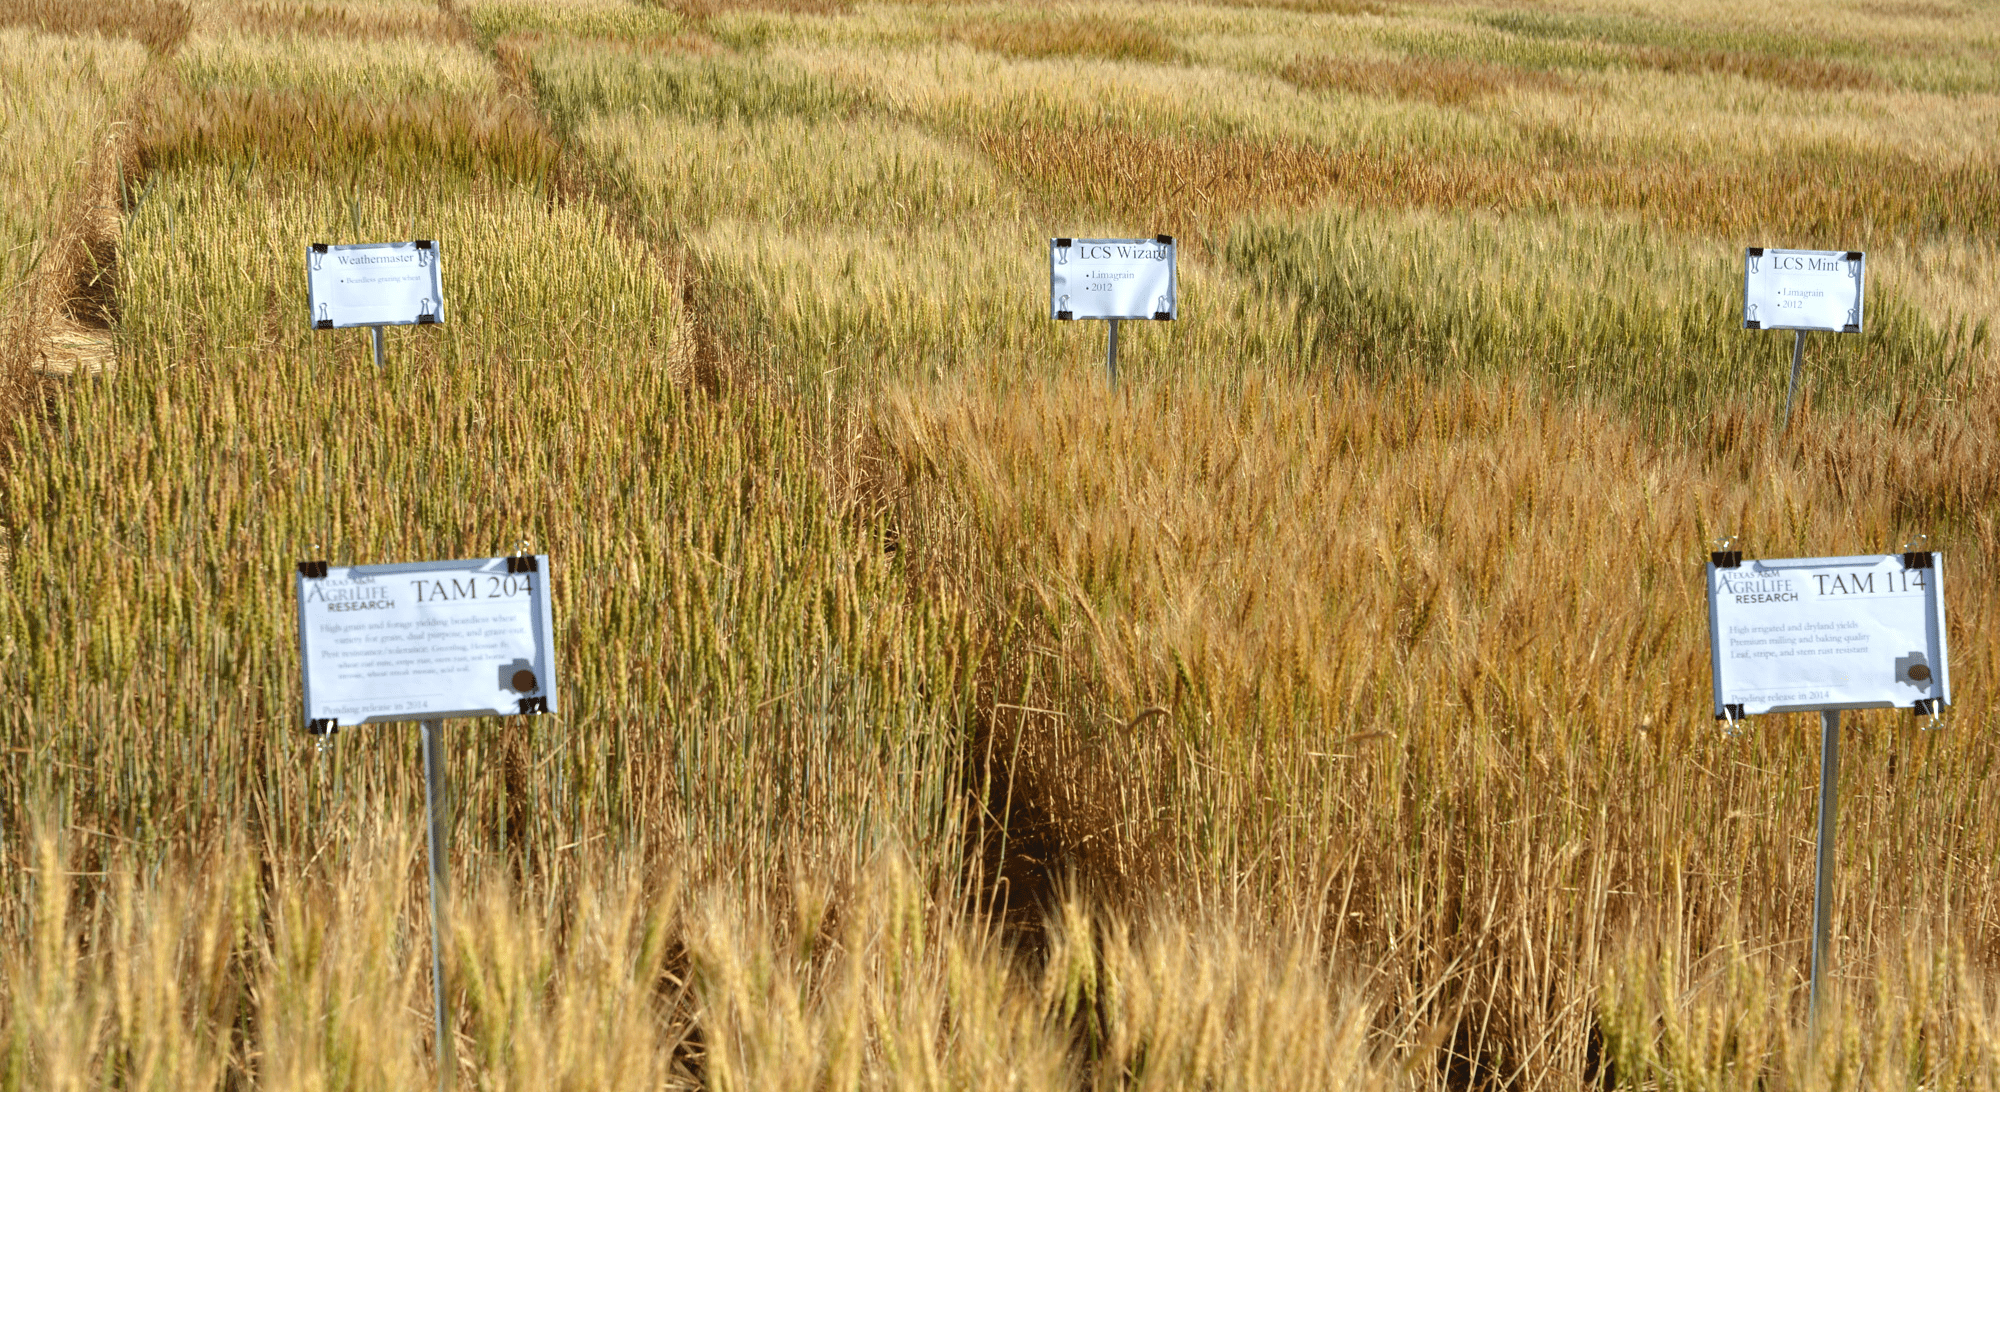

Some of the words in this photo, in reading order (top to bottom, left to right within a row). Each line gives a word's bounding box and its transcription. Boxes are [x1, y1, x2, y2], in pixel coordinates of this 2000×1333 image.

[1080, 246, 1112, 260] LCS
[1116, 245, 1168, 260] Wizard
[338, 254, 414, 266] Weathermaster
[1774, 256, 1804, 271] LCS
[1808, 257, 1840, 272] Mint
[402, 274, 421, 282] wheat
[1092, 270, 1135, 282] Limagrain
[1091, 283, 1113, 292] 2012
[1783, 287, 1825, 299] Limagrain
[1782, 300, 1803, 309] 2012
[410, 577, 477, 603] TAM
[487, 574, 534, 599] 204
[1812, 571, 1875, 596] TAM
[1886, 569, 1926, 593] 114
[1735, 592, 1799, 604] RESEARCH
[327, 599, 396, 613] RESEARCH
[1729, 624, 1750, 636] High
[1752, 622, 1786, 634] irrigated
[1787, 622, 1802, 632] and
[1804, 619, 1835, 632] dryland
[1836, 619, 1859, 631] yields
[1730, 636, 1767, 647] Premium
[1769, 634, 1797, 646] milling
[1799, 633, 1814, 644] and
[1815, 632, 1843, 644] baking
[1844, 631, 1871, 644] quality
[1780, 647, 1796, 658] and
[1796, 647, 1816, 656] stem
[1817, 645, 1834, 655] rust
[1835, 645, 1869, 655] resistant
[1767, 691, 1796, 702] release
[1797, 691, 1808, 701] in
[1808, 689, 1831, 701] 2014
